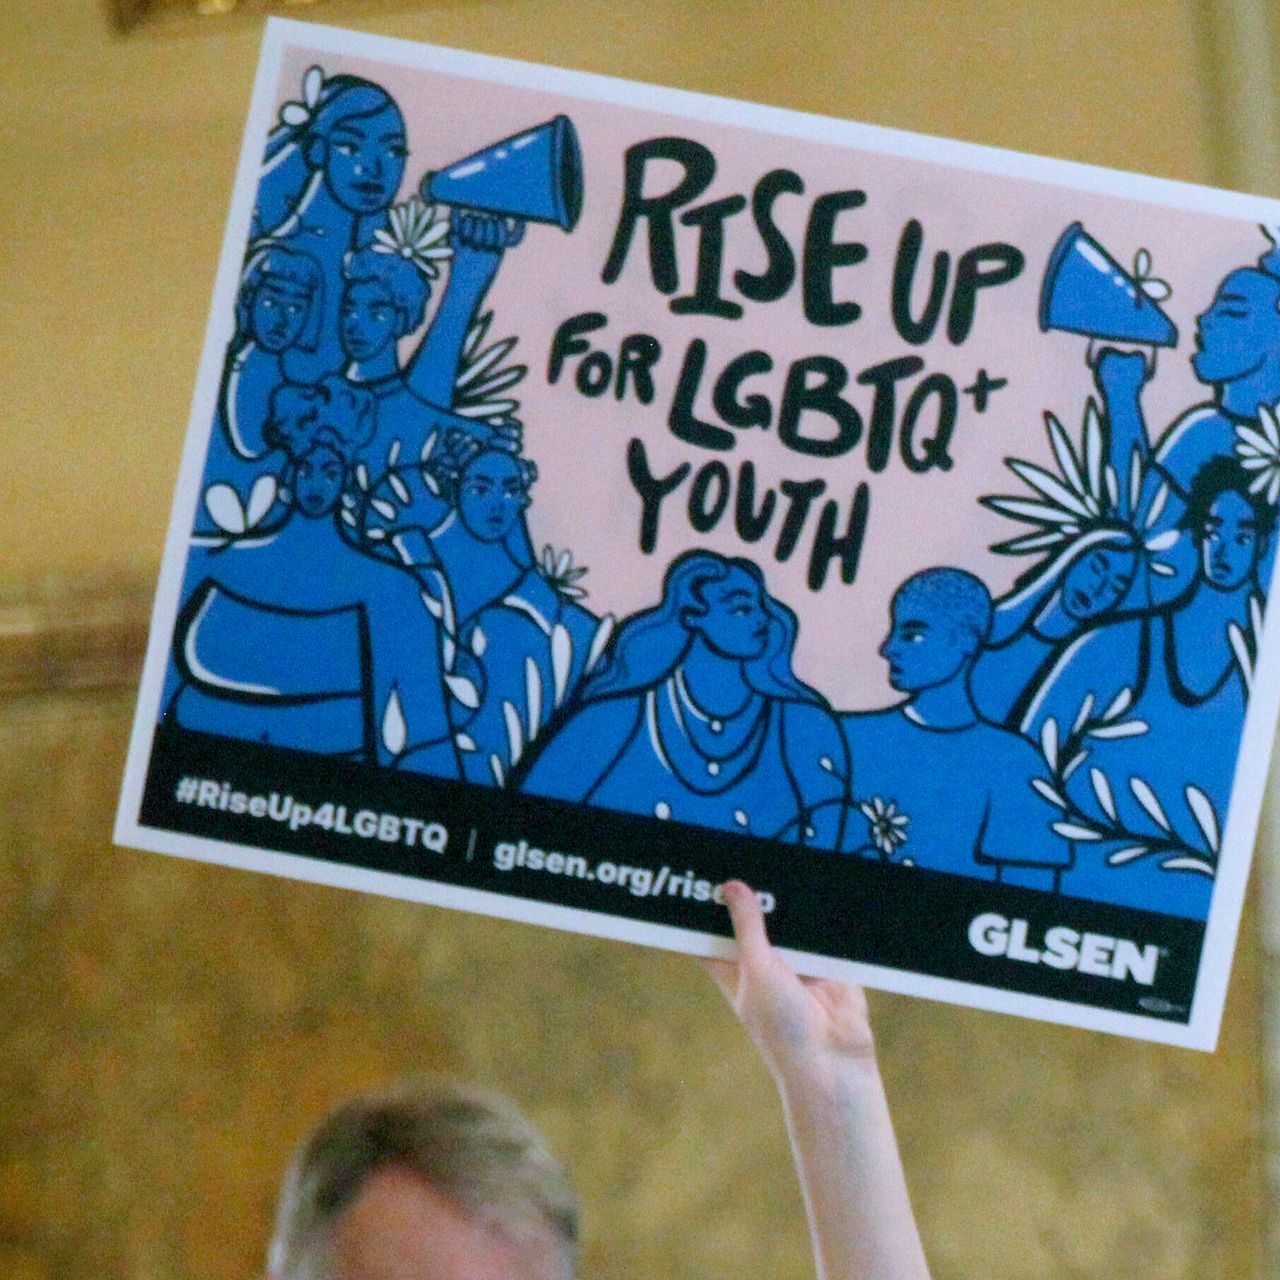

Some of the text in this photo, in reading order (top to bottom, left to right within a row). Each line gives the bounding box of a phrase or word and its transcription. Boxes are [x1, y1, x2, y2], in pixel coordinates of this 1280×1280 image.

[601, 136, 1026, 345] RISE UP
[548, 312, 1009, 474] FOR LGBTQ+
[627, 437, 870, 592] YOUTH
[175, 775, 775, 914] #RiseUp4LGBTQ glsen.org/risp
[967, 912, 1159, 986] GLSEN
